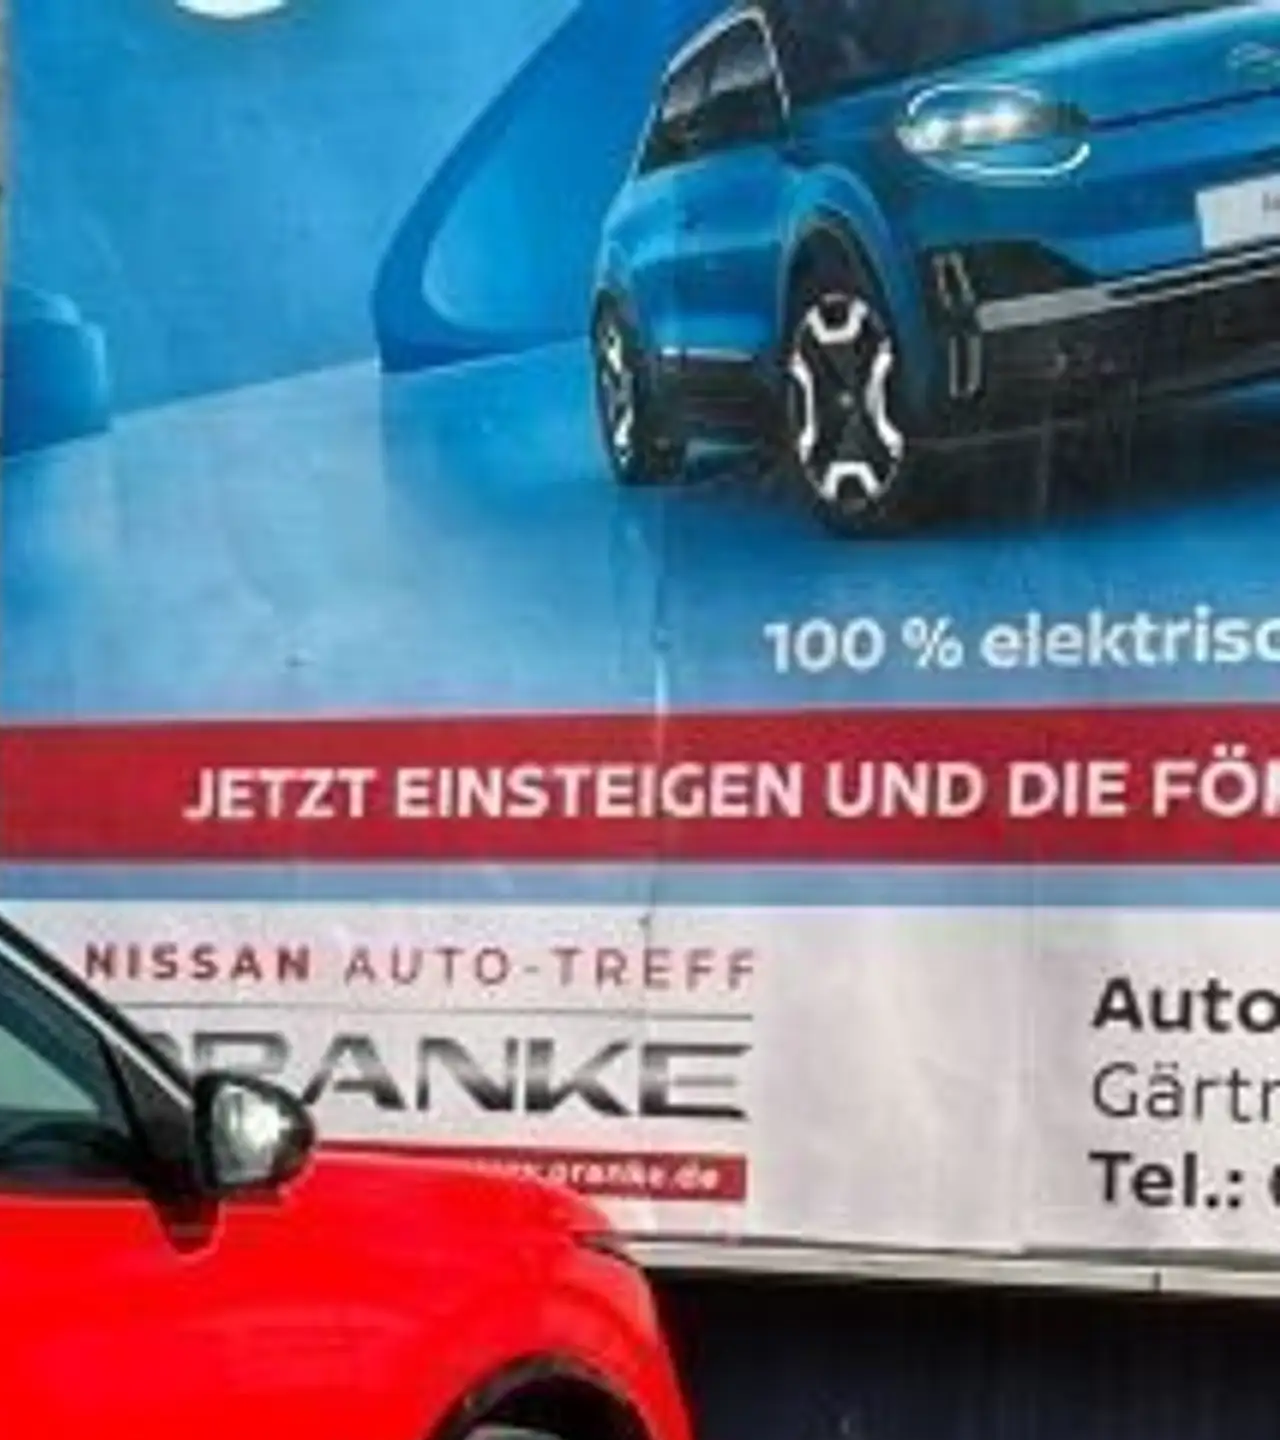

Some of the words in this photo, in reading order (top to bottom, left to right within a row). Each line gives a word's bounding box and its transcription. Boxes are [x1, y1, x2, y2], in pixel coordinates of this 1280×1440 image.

[764, 617, 886, 674] 100
[901, 614, 964, 670] %
[182, 767, 375, 820] JETZT
[395, 761, 803, 819] EINSTEIGEN
[827, 760, 986, 819] UND
[1007, 760, 1130, 819] DIE
[84, 941, 312, 982] NISSAN
[344, 945, 754, 992] AUTO-TREFF
[1091, 976, 1280, 1033] Auto
[143, 1030, 753, 1122] RANKE
[1088, 1151, 1243, 1208] Tel.:
